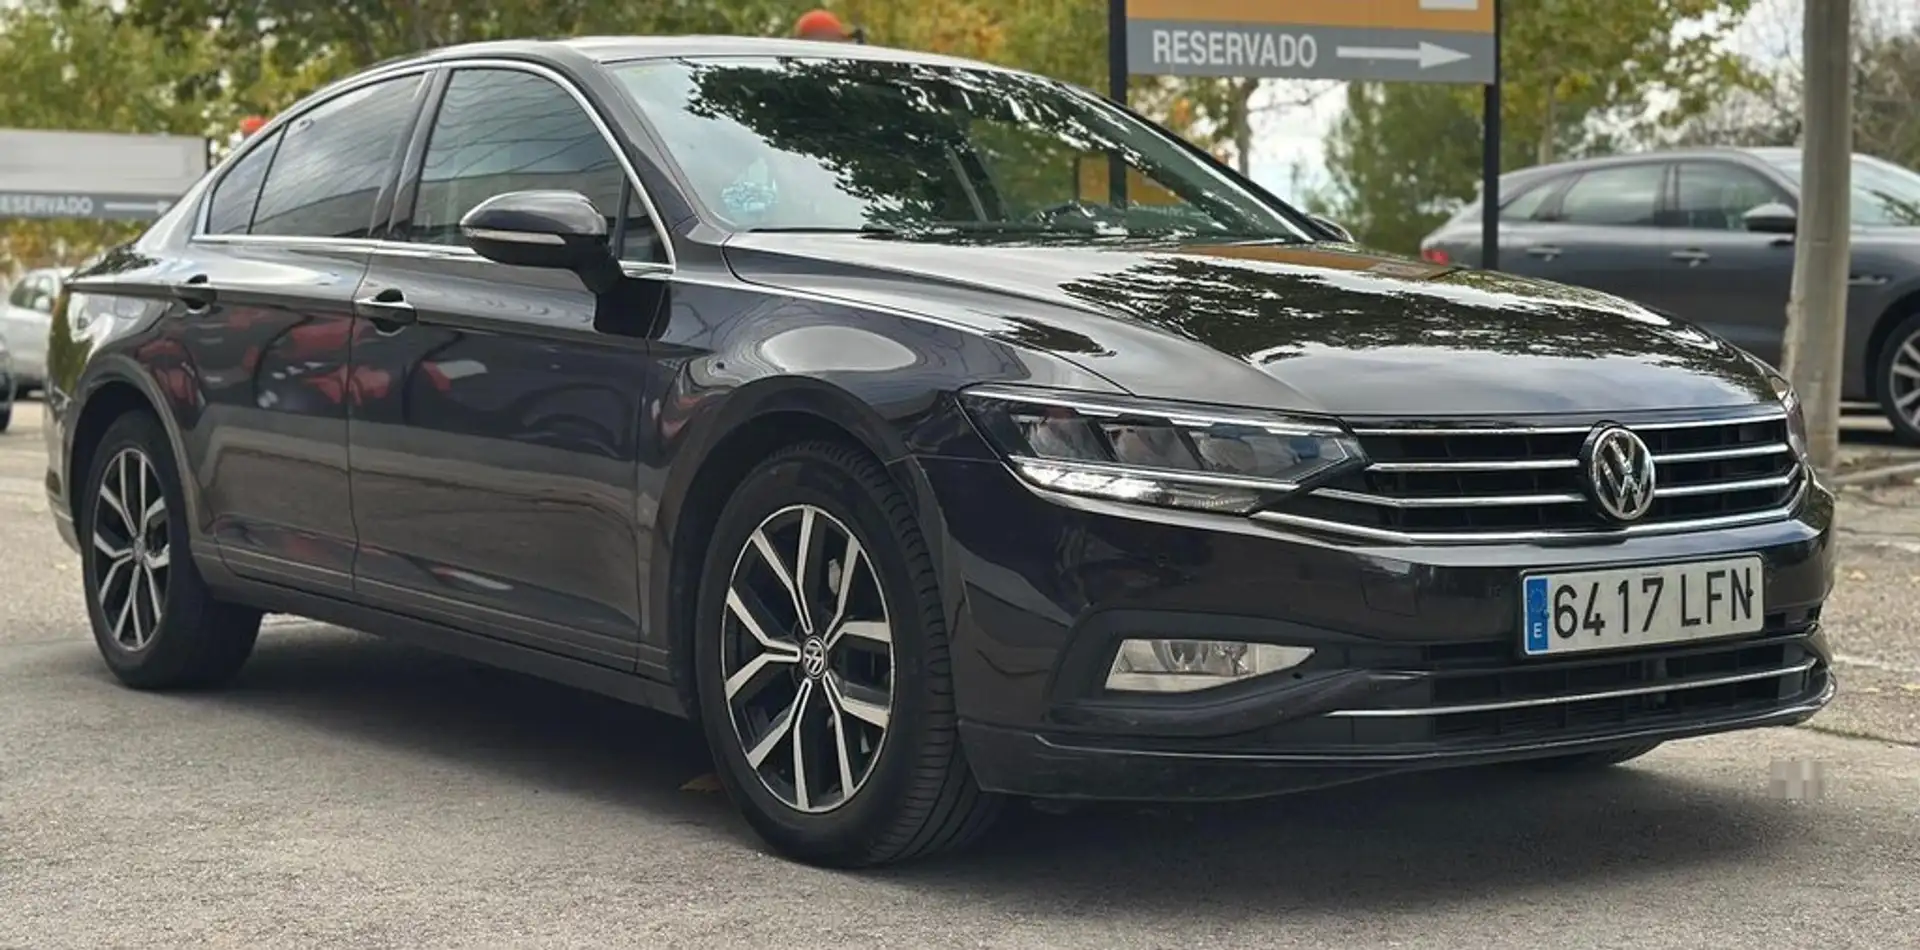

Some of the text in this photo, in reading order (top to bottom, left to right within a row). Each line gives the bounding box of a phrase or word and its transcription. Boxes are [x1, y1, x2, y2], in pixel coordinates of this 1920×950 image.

[1152, 29, 1318, 68] RESERVADO
[0, 195, 94, 216] ESERVADO
[1533, 567, 1753, 639] E 6417 LFN
